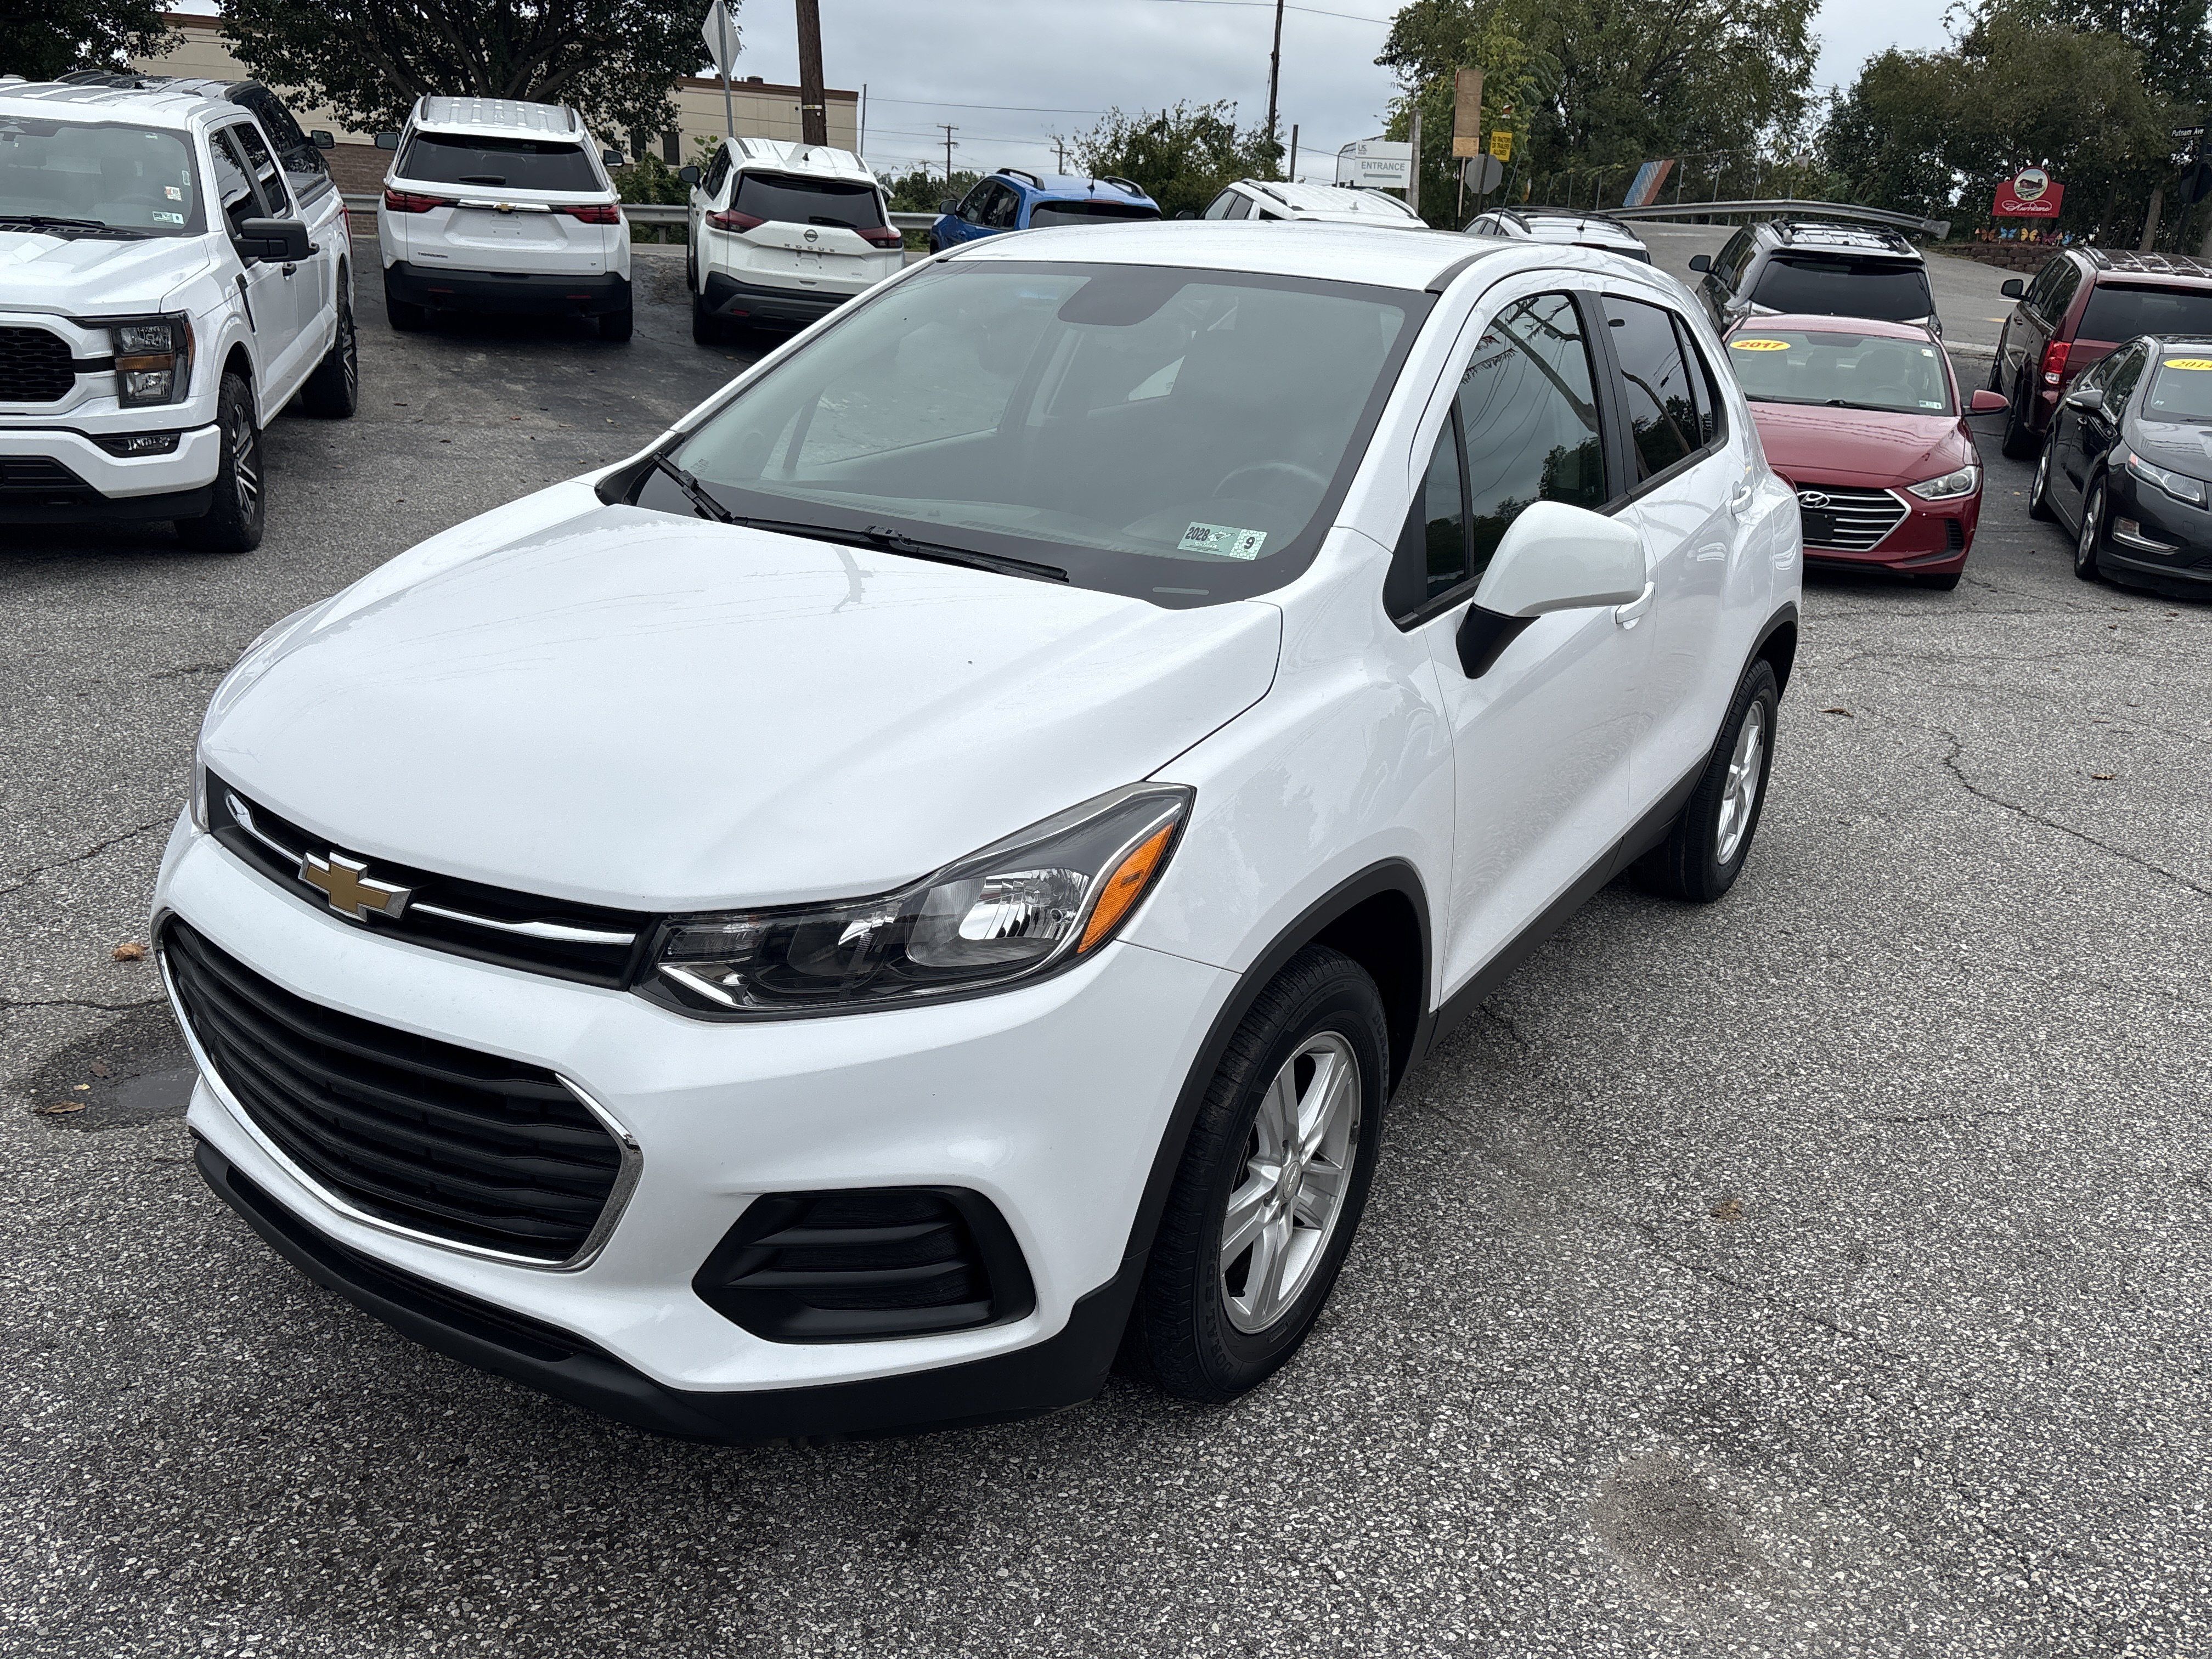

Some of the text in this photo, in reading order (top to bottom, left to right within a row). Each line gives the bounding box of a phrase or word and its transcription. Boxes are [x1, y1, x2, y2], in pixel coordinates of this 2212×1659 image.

[1361, 161, 1406, 171] ENTRANCE
[784, 243, 835, 252] ROGUE
[1185, 526, 1211, 541] 2028
[1244, 537, 1256, 549] 9
